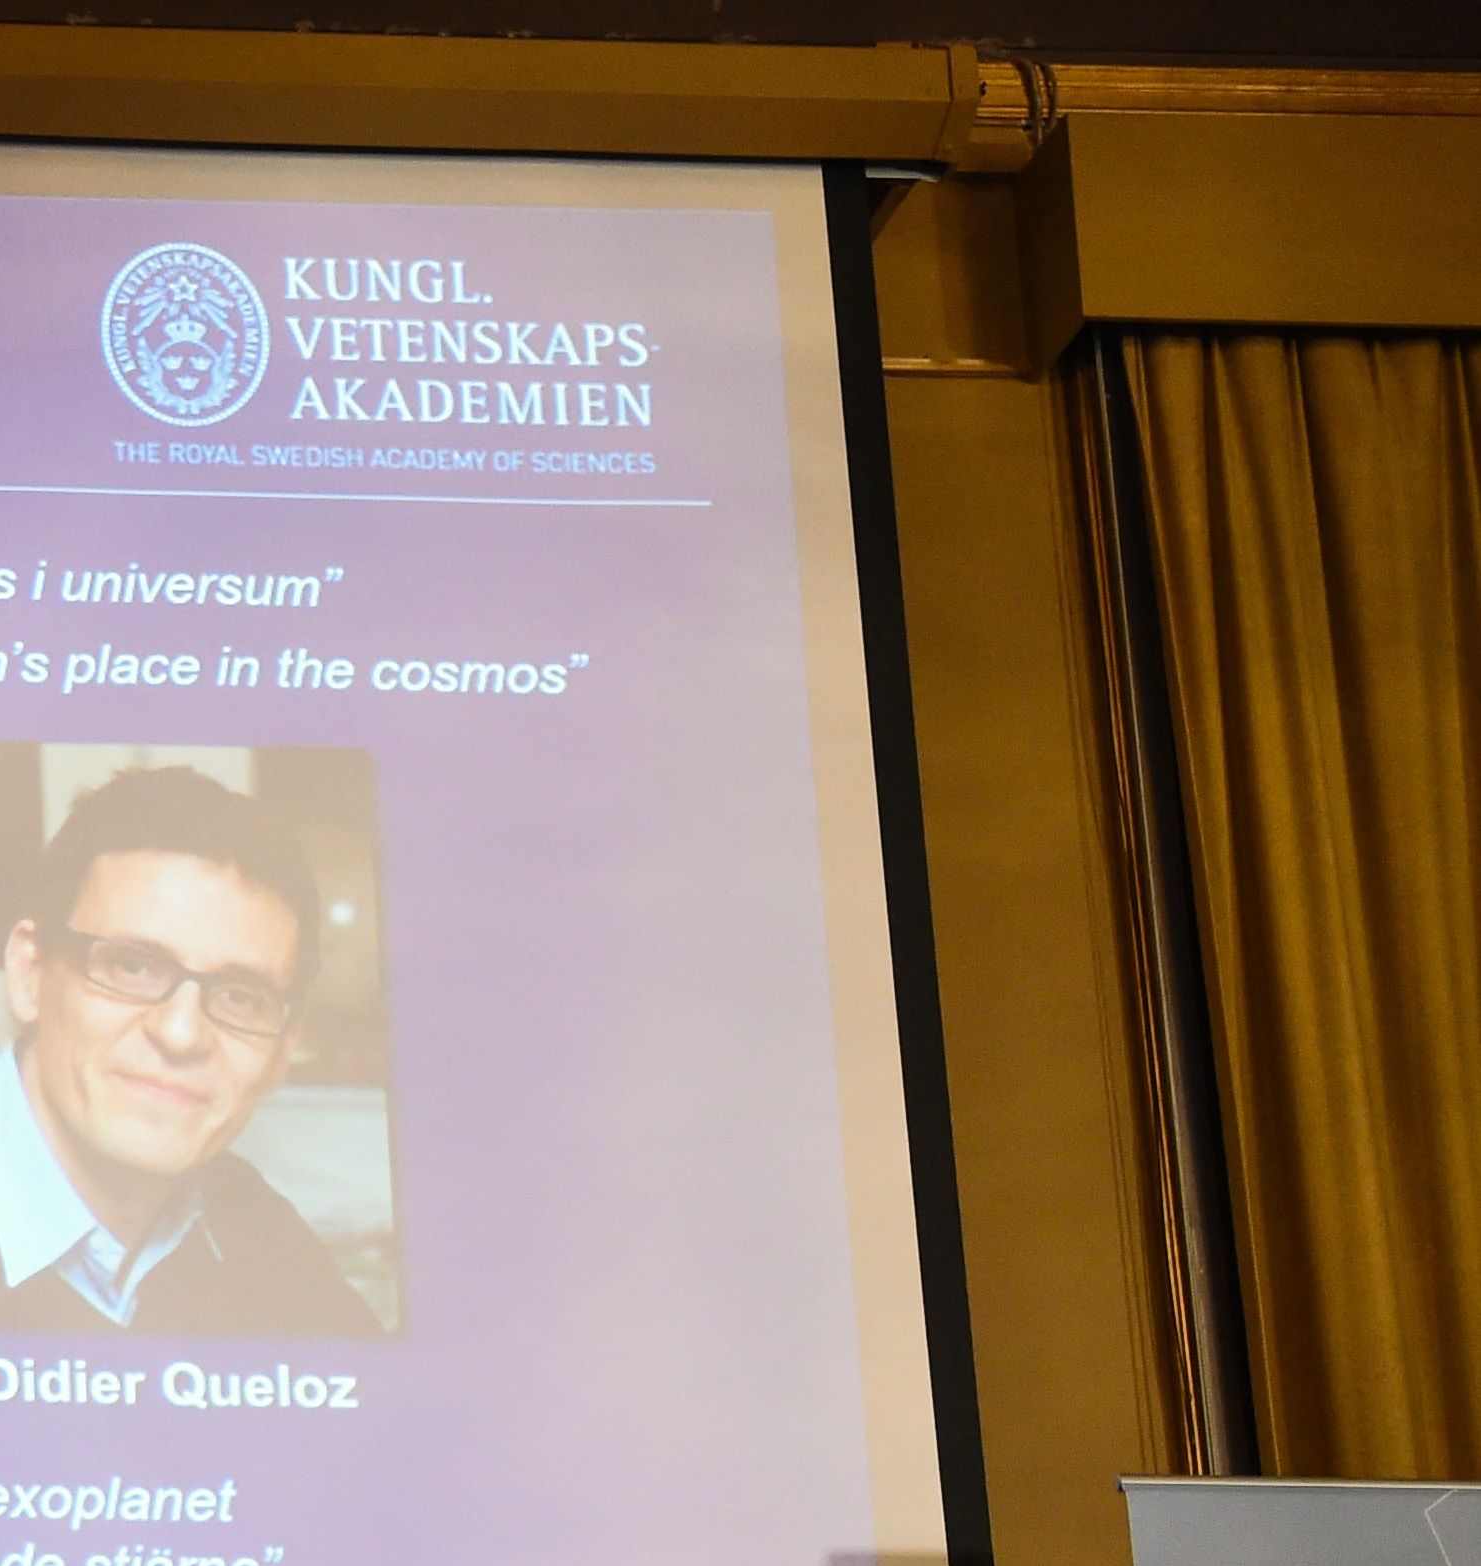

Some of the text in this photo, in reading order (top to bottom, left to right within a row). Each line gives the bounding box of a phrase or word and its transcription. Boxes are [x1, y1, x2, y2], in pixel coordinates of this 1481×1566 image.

[284, 256, 493, 304] KUNGL.
[285, 316, 659, 367] VETENSKAPS-
[290, 376, 651, 427] AKADEMIEN
[113, 441, 657, 475] THE ROYAL SWEDISH ACADEMY OF SCIENCES
[31, 559, 48, 601] i
[62, 643, 201, 695] place
[216, 645, 260, 688] in
[277, 647, 356, 690] the
[161, 1361, 359, 1410] Queloz
